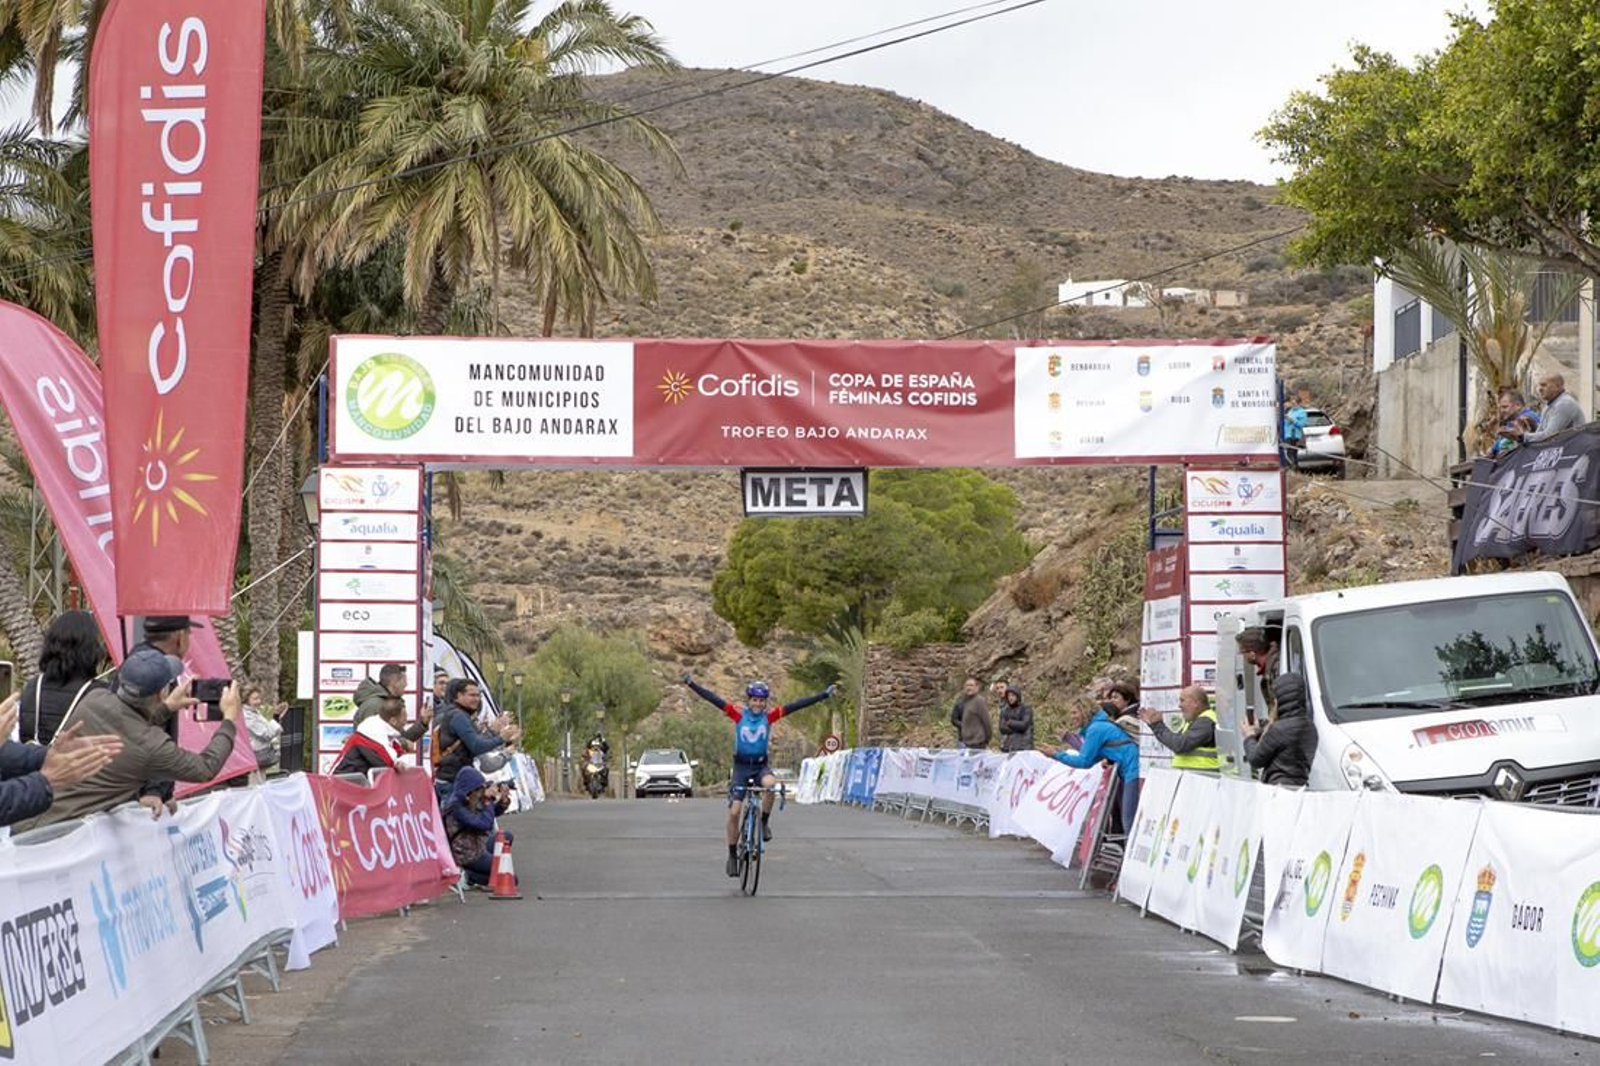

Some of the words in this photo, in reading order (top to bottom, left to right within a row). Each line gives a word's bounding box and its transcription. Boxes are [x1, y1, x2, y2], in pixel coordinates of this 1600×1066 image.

[469, 364, 605, 382] MANCOMUNIDAD
[829, 373, 875, 388] COPA
[881, 374, 902, 388] DE
[908, 372, 975, 389] ESPAÑA
[697, 373, 800, 397] Cofidis
[474, 390, 494, 408] DE
[502, 391, 600, 409] MUNICIPIOS
[828, 389, 903, 405] FÉMINAS
[908, 391, 978, 406] COFIDIS
[455, 416, 485, 434] DEL
[492, 417, 532, 434] BAJO
[540, 418, 618, 435] ANDARAX
[721, 425, 789, 438] TROFEO
[795, 426, 840, 439] BAJO
[845, 427, 927, 440] ANDARAX
[751, 477, 859, 507] META
[350, 522, 399, 536] aqualia
[1218, 522, 1265, 538] aqualia
[342, 610, 371, 621] eco
[1446, 716, 1537, 741] cronomur
[348, 792, 439, 873] Cofidis
[2, 897, 87, 1027] INVERSE
